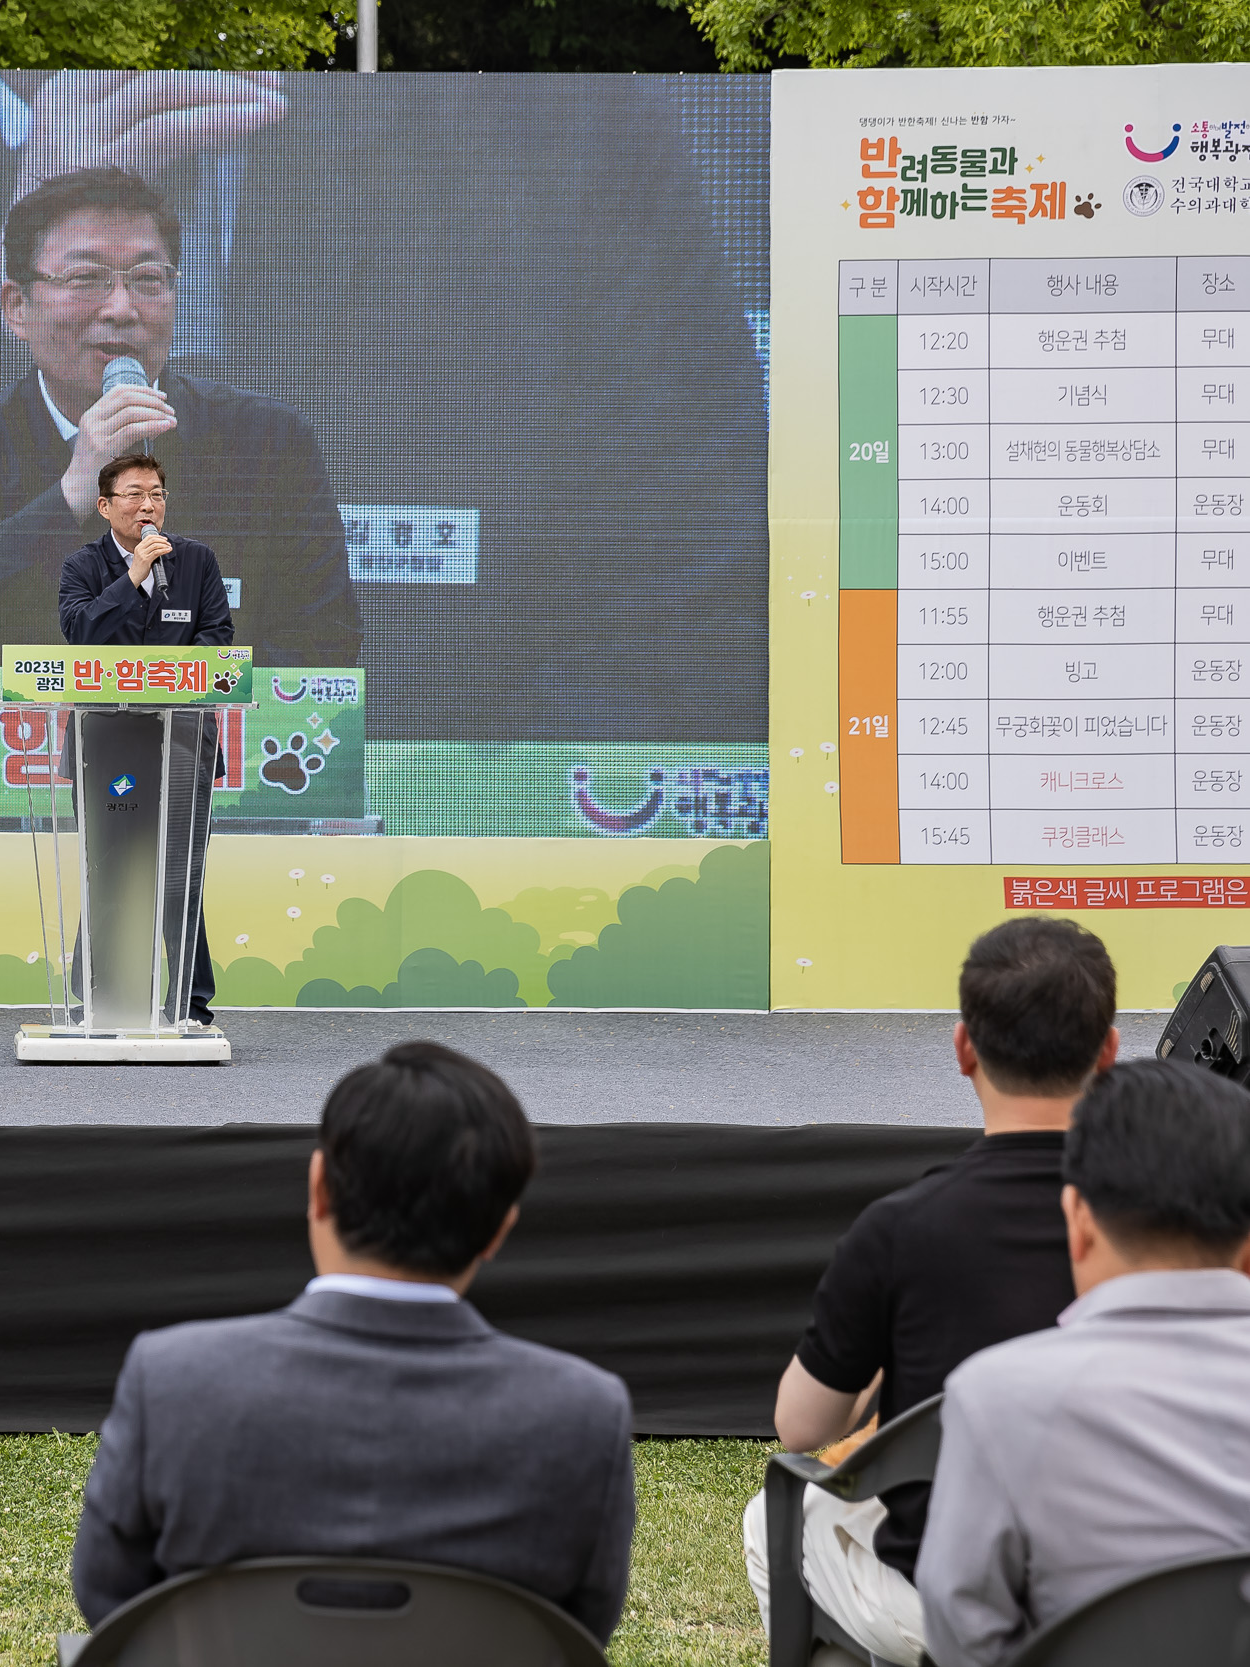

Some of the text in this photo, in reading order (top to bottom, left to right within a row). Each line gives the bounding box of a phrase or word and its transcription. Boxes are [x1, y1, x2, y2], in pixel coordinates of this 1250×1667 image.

[859, 117, 894, 127] 댕댕이가
[898, 116, 937, 127] 반한축제!
[941, 116, 967, 126] 신나는
[971, 115, 988, 125] 반함
[860, 136, 1018, 183] 반려동물과
[857, 181, 1067, 229] 함께하는 축제
[910, 275, 977, 298] 시작시간
[1047, 274, 1119, 296] 행사 내용
[1202, 273, 1235, 295] 장소
[919, 332, 969, 351] 12:20
[1038, 329, 1127, 352] 행운권 추첨
[1201, 328, 1234, 350] 무대
[919, 387, 969, 405] 12:30
[1057, 384, 1107, 406] 기념식
[1201, 383, 1235, 404] 무대
[849, 441, 889, 464] 20일
[919, 442, 969, 460] 13:00
[1005, 439, 1161, 462] 설채현의 동물행복상담소
[1201, 438, 1235, 460] 무대
[919, 497, 969, 515] 14:00
[1057, 495, 1108, 517] 운동회
[1193, 494, 1244, 516] 운동장
[919, 552, 969, 570] 15:00
[1057, 550, 1108, 572] 이벤트
[1201, 549, 1234, 570] 무대
[919, 607, 968, 626] 11:55
[1037, 605, 1126, 628] 행운권 추첨
[1200, 604, 1234, 626] 무대
[15, 660, 65, 675] 2023년
[919, 662, 968, 680] 12:00
[1064, 660, 1098, 683] 빙고
[1191, 659, 1242, 682] 운동장
[36, 677, 65, 691] 광진
[848, 715, 889, 739] 21일
[919, 717, 968, 736] 12:45
[995, 714, 1168, 738] 무궁화꽃이 피었습니다
[1191, 714, 1242, 737] 운동장
[919, 772, 969, 791] 14:00
[1040, 771, 1124, 793] 캐니크로스
[1192, 769, 1243, 792] 운동장
[106, 802, 139, 812] 광진구
[920, 827, 970, 845] 15:45
[1041, 825, 1125, 848] 쿠킹클래스
[1192, 824, 1243, 847] 운동장
[1010, 878, 1248, 906] 붉은색 글씨 프로그램은
